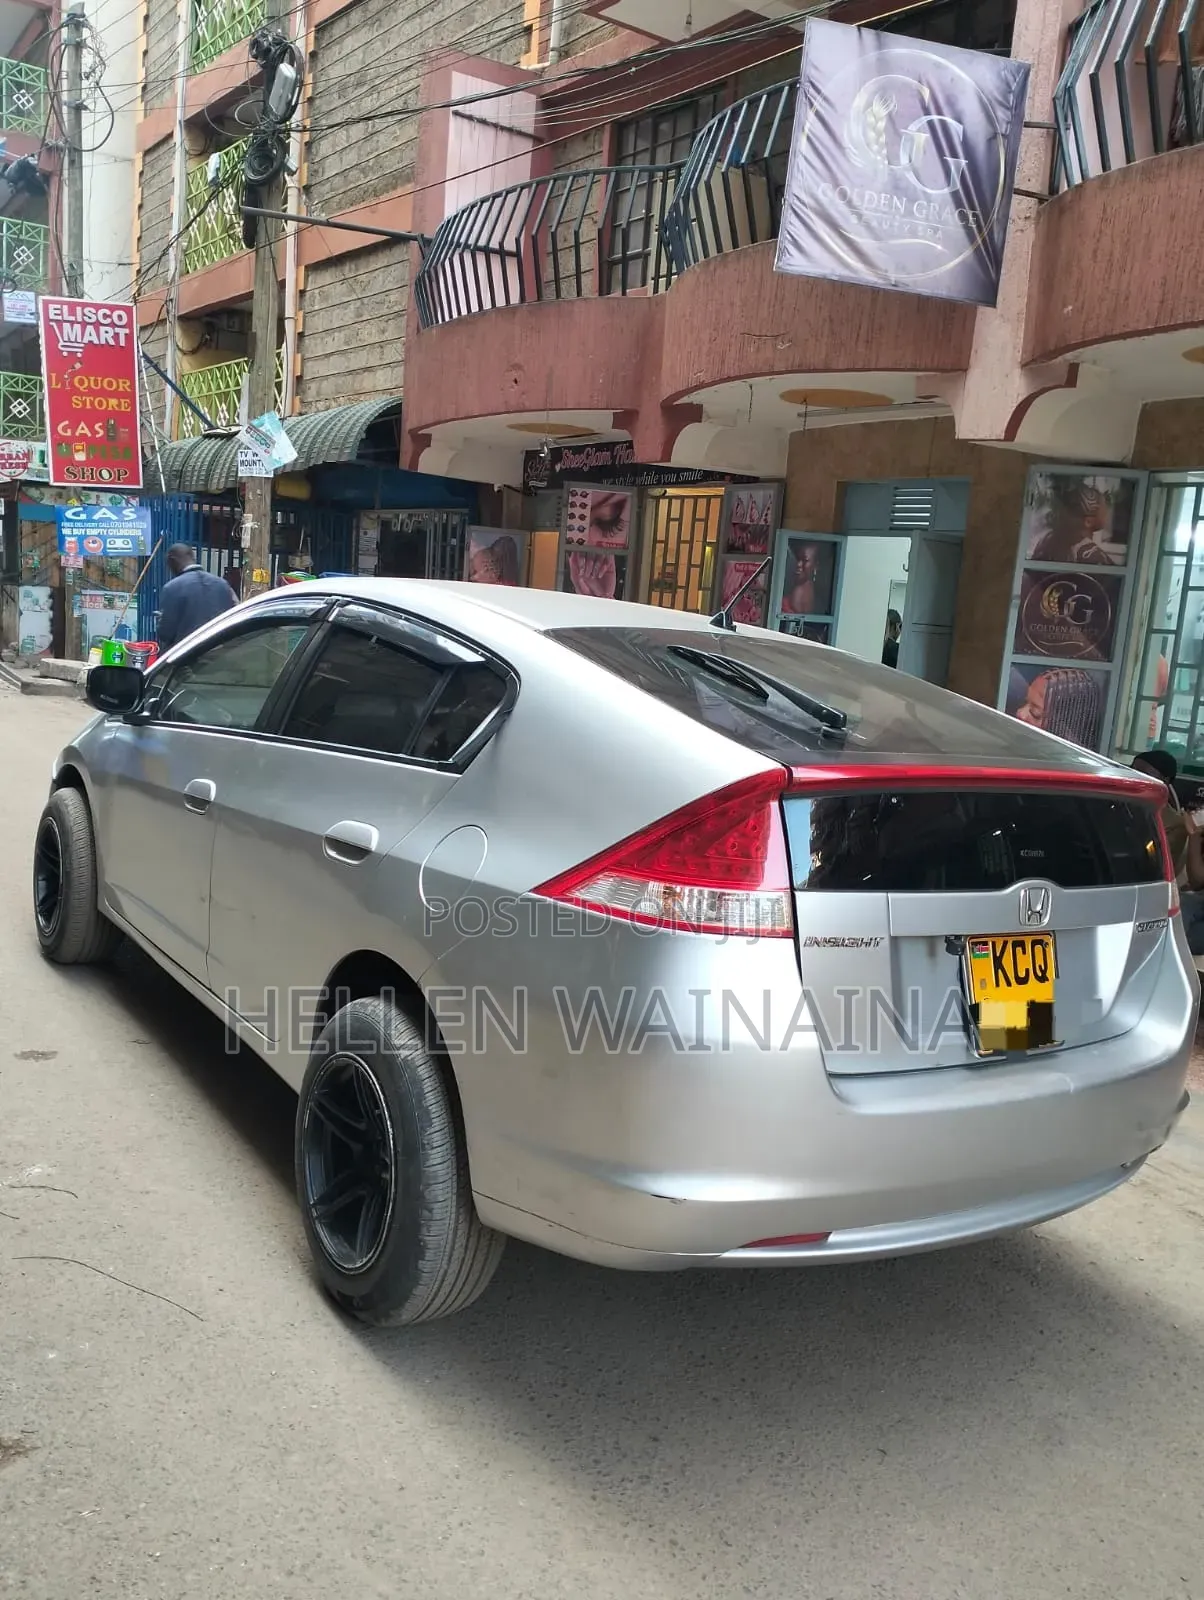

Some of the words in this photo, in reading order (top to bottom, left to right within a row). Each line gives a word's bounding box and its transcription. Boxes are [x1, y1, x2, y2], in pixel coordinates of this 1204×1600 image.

[818, 182, 907, 215] GOLDEN
[913, 200, 978, 228] GRACE
[48, 303, 128, 326] ELISCO
[62, 322, 130, 347] MART
[71, 395, 132, 412] STORE
[57, 420, 105, 438] GAS
[64, 465, 129, 482] SHOP
[635, 471, 659, 486] while
[660, 473, 677, 485] you
[680, 469, 704, 482] smile
[65, 507, 137, 521] GAS
[1030, 623, 1067, 634] GOLDEN
[803, 935, 885, 948] INSIGHT
[991, 938, 1050, 988] KCQ
